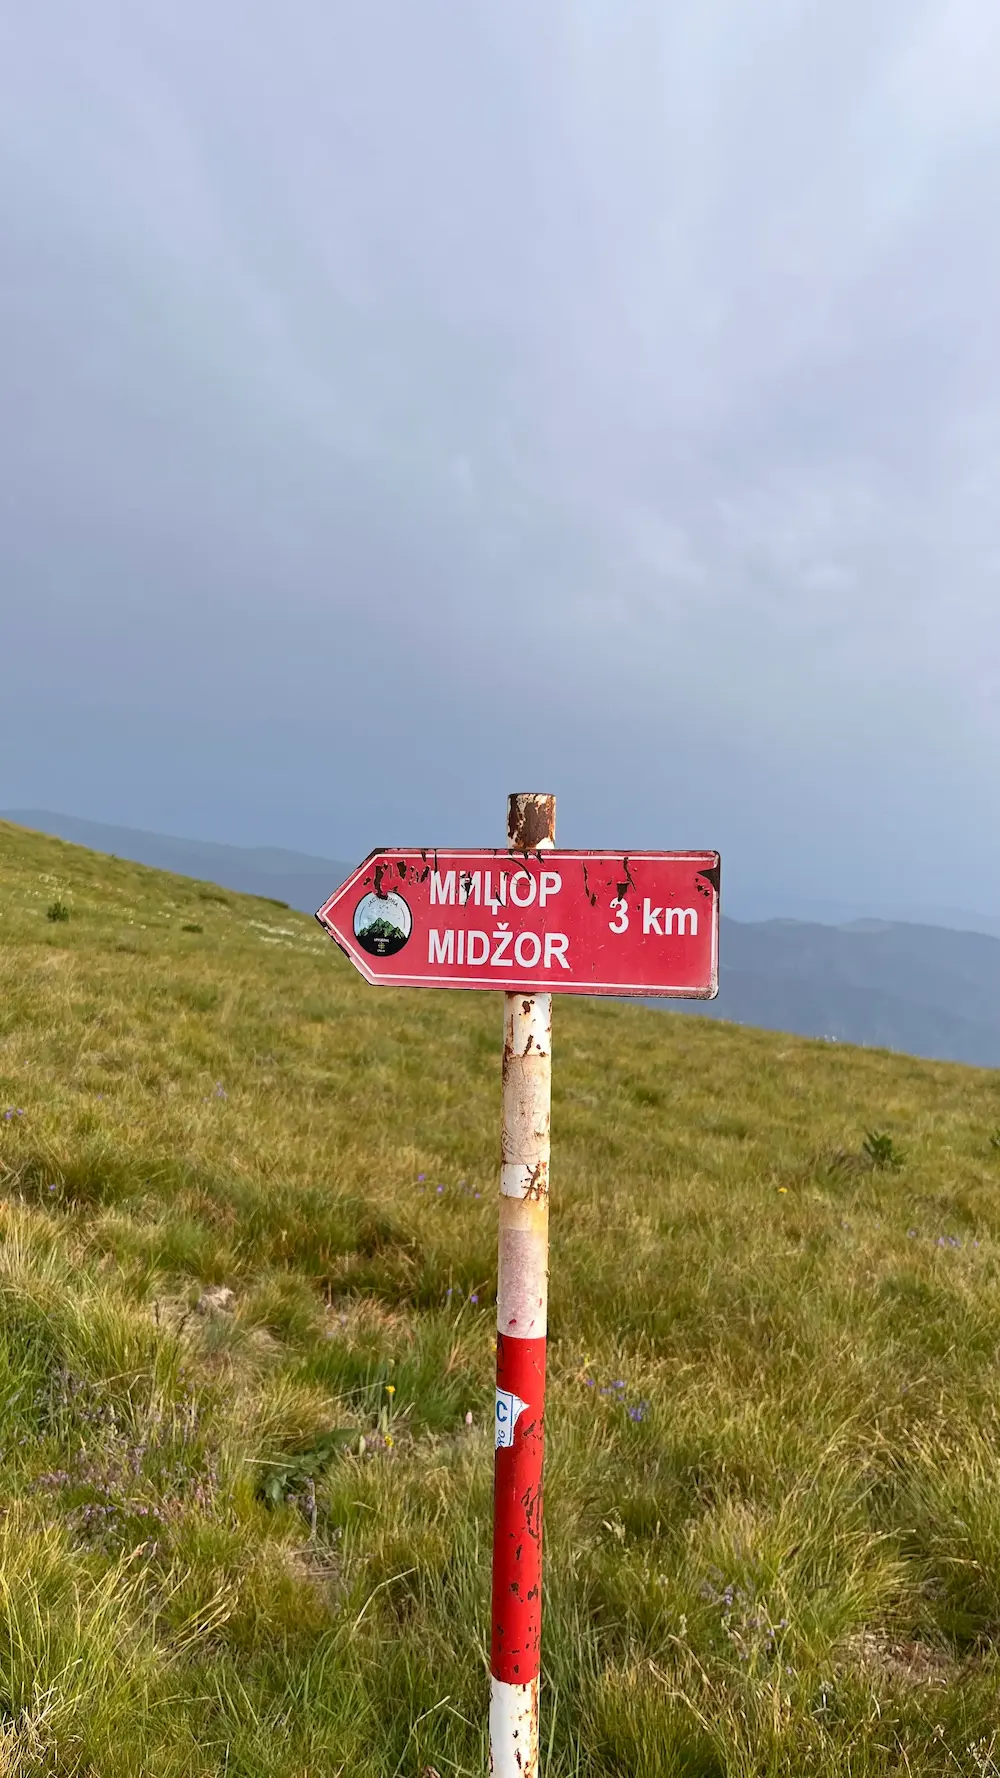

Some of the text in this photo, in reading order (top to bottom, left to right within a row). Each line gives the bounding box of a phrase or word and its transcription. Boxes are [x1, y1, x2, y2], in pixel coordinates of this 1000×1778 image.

[429, 870, 563, 916] МИЏОР
[608, 897, 698, 936] 3 km
[427, 922, 571, 970] MIDŽOR
